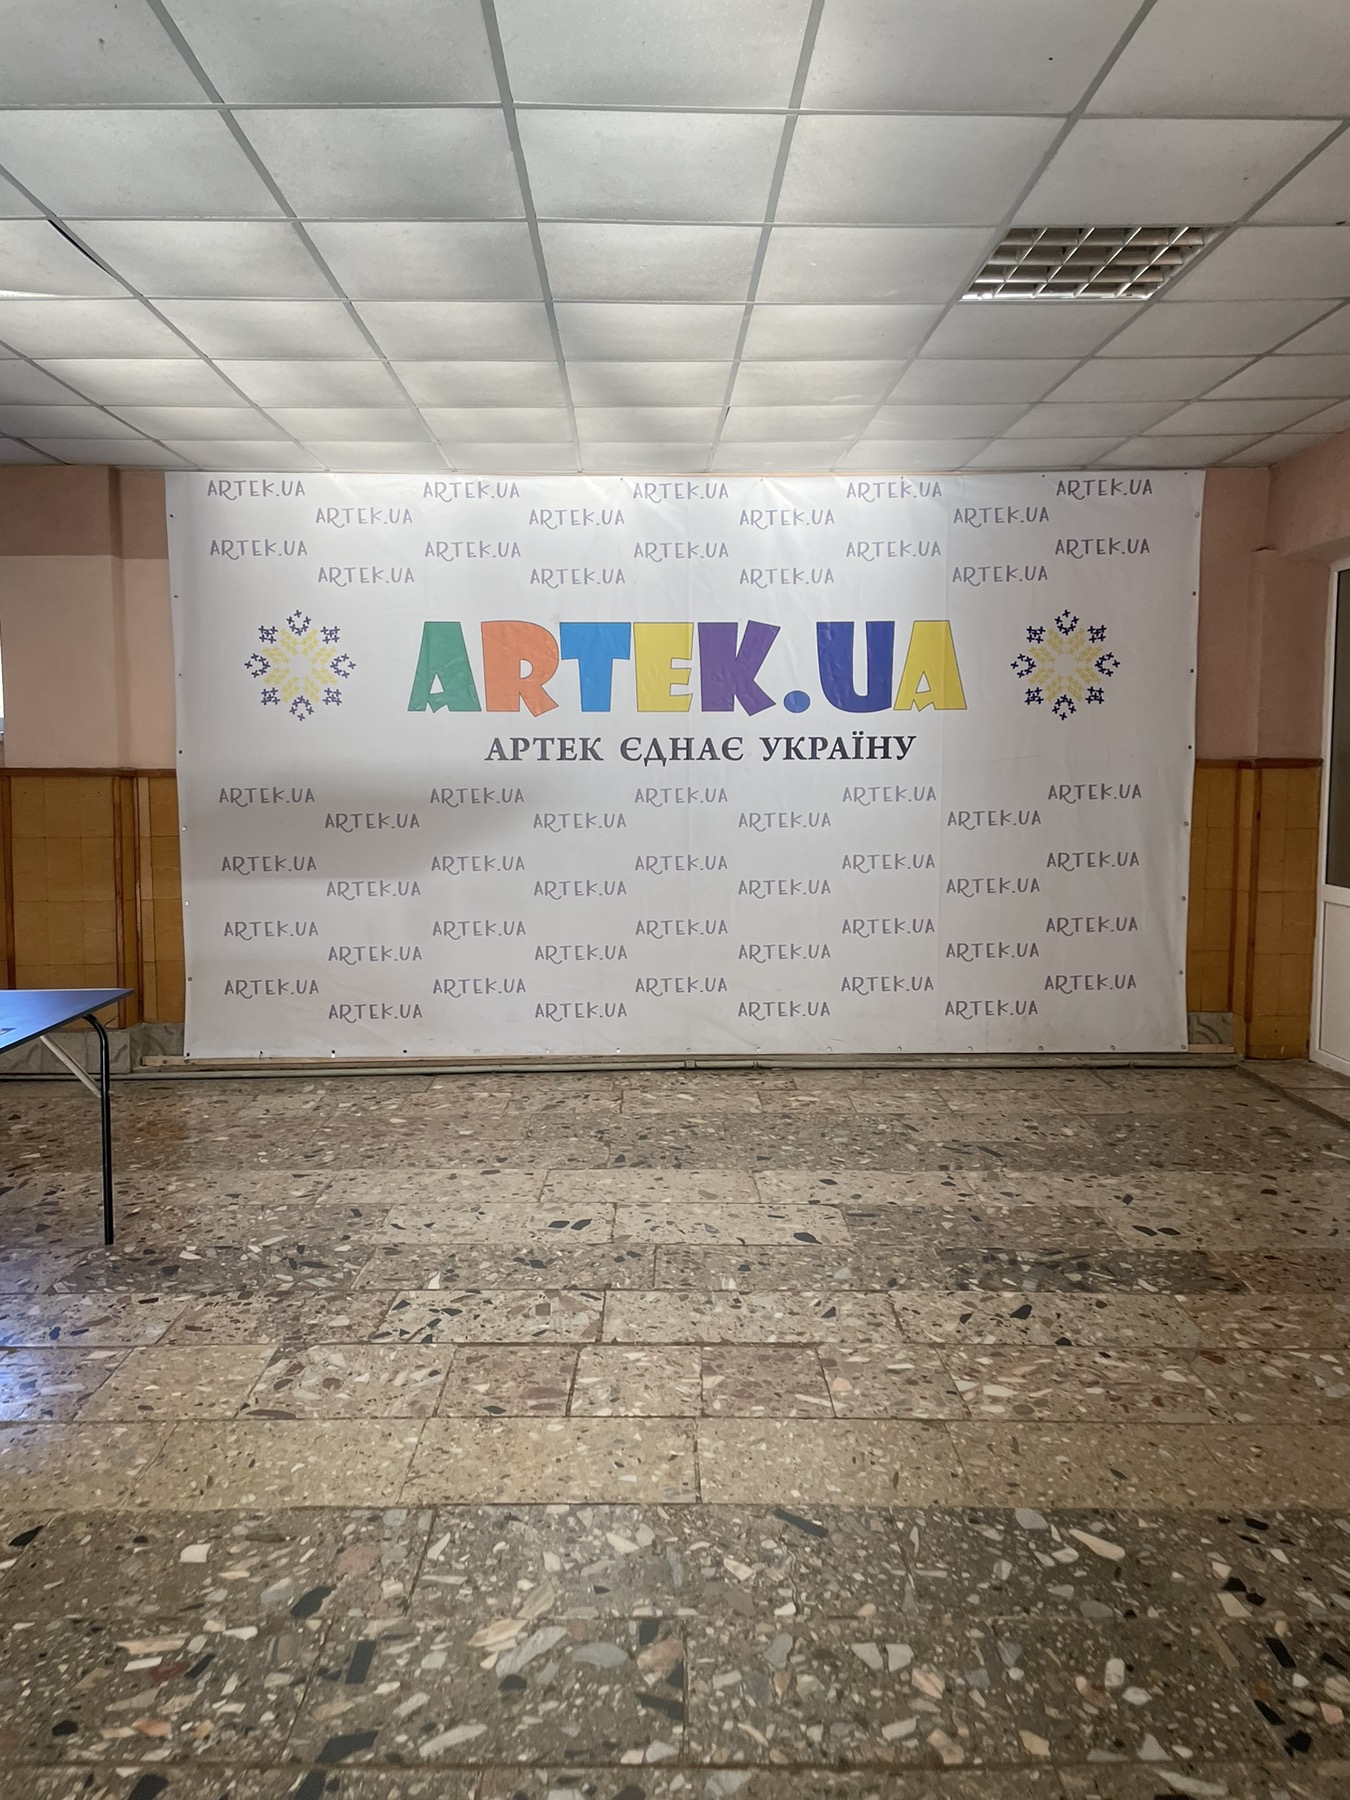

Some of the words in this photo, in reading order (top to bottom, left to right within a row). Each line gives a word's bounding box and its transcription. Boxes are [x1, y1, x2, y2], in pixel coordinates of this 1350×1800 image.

[207, 480, 305, 500] ARTEK.UA
[423, 482, 519, 502] ARTEK.UA
[632, 482, 728, 503] ARTEK.UA
[846, 481, 941, 502] ARTEK.UA
[1055, 478, 1152, 500] ARTEK.UA
[315, 507, 412, 528] ARTEK.UA
[528, 509, 624, 529] ARTEK.UA
[739, 509, 834, 529] ARTEK.UA
[953, 506, 1049, 528] ARTEK.UA
[210, 539, 307, 560] ARTEK.UA
[424, 541, 520, 561] ARTEK.UA
[633, 542, 728, 562] ARTEK.UA
[845, 540, 940, 561] ARTEK.UA
[1054, 538, 1150, 559] ARTEK.UA
[317, 567, 414, 587] ARTEK.UA
[530, 568, 625, 588] ARTEK.UA
[739, 568, 834, 588] ARTEK.UA
[952, 565, 1047, 586] ARTEK.UA
[407, 620, 967, 716] ARTEK.UA
[484, 737, 604, 761] АРТЕК
[620, 736, 744, 767] ЄДНАЄ
[759, 731, 917, 761] УКРАЇНУ
[218, 787, 314, 807] ARTEK.UA
[430, 787, 524, 807] ARTEK.UA
[634, 787, 727, 807] ARTEK.UA
[842, 786, 936, 806] ARTEK.UA
[1047, 783, 1141, 804] ARTEK.UA
[324, 813, 419, 832] ARTEK.UA
[533, 813, 626, 832] ARTEK.UA
[738, 812, 831, 832] ARTEK.UA
[947, 810, 1041, 830] ARTEK.UA
[221, 855, 316, 875] ARTEK.UA
[431, 855, 524, 875] ARTEK.UA
[634, 855, 727, 874] ARTEK.UA
[841, 853, 935, 873] ARTEK.UA
[1046, 851, 1139, 871] ARTEK.UA
[326, 881, 420, 900] ARTEK.UA
[533, 880, 626, 900] ARTEK.UA
[737, 879, 830, 899] ARTEK.UA
[946, 877, 1040, 897] ARTEK.UA
[223, 921, 318, 940] ARTEK.UA
[432, 920, 525, 940] ARTEK.UA
[635, 919, 727, 939] ARTEK.UA
[841, 918, 934, 938] ARTEK.UA
[1045, 916, 1137, 936] ARTEK.UA
[328, 946, 422, 965] ARTEK.UA
[534, 945, 627, 964] ARTEK.UA
[738, 944, 830, 963] ARTEK.UA
[945, 942, 1039, 962] ARTEK.UA
[224, 979, 319, 999] ARTEK.UA
[432, 978, 526, 998] ARTEK.UA
[634, 977, 727, 996] ARTEK.UA
[840, 976, 933, 995] ARTEK.UA
[1044, 974, 1136, 994] ARTEK.UA
[328, 1003, 422, 1023] ARTEK.UA
[534, 1002, 627, 1022] ARTEK.UA
[737, 1001, 830, 1021] ARTEK.UA
[944, 1000, 1038, 1019] ARTEK.UA
